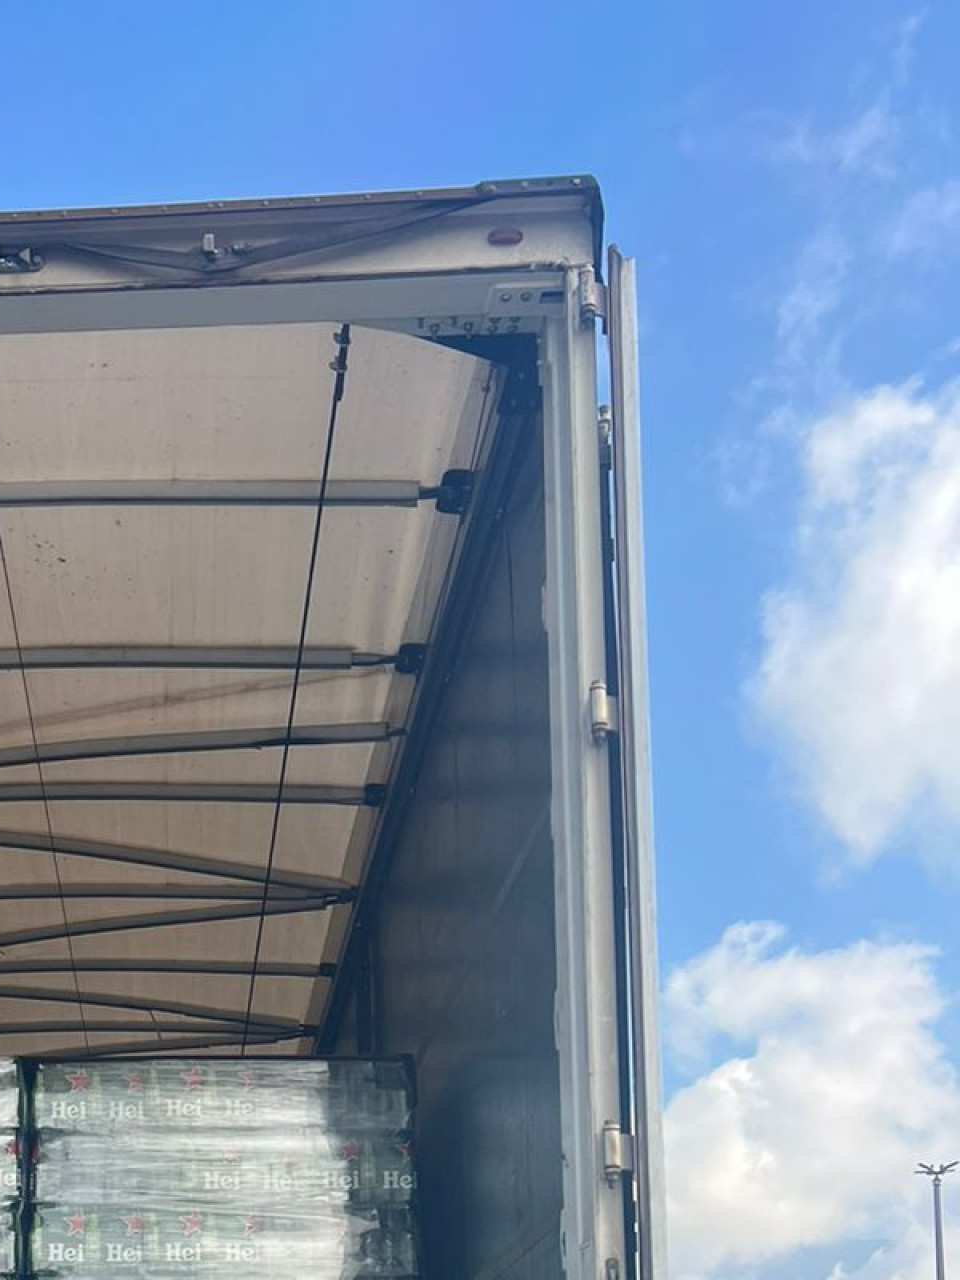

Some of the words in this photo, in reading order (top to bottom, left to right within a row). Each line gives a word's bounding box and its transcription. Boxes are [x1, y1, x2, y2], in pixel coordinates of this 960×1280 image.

[51, 1102, 86, 1118] Hei
[108, 1101, 144, 1118] Hei
[167, 1100, 202, 1116] Hei
[204, 1171, 240, 1189] Hei
[323, 1171, 358, 1188] Hei
[49, 1245, 83, 1261] Hei
[107, 1244, 141, 1261] Hei
[167, 1244, 201, 1261] Hei
